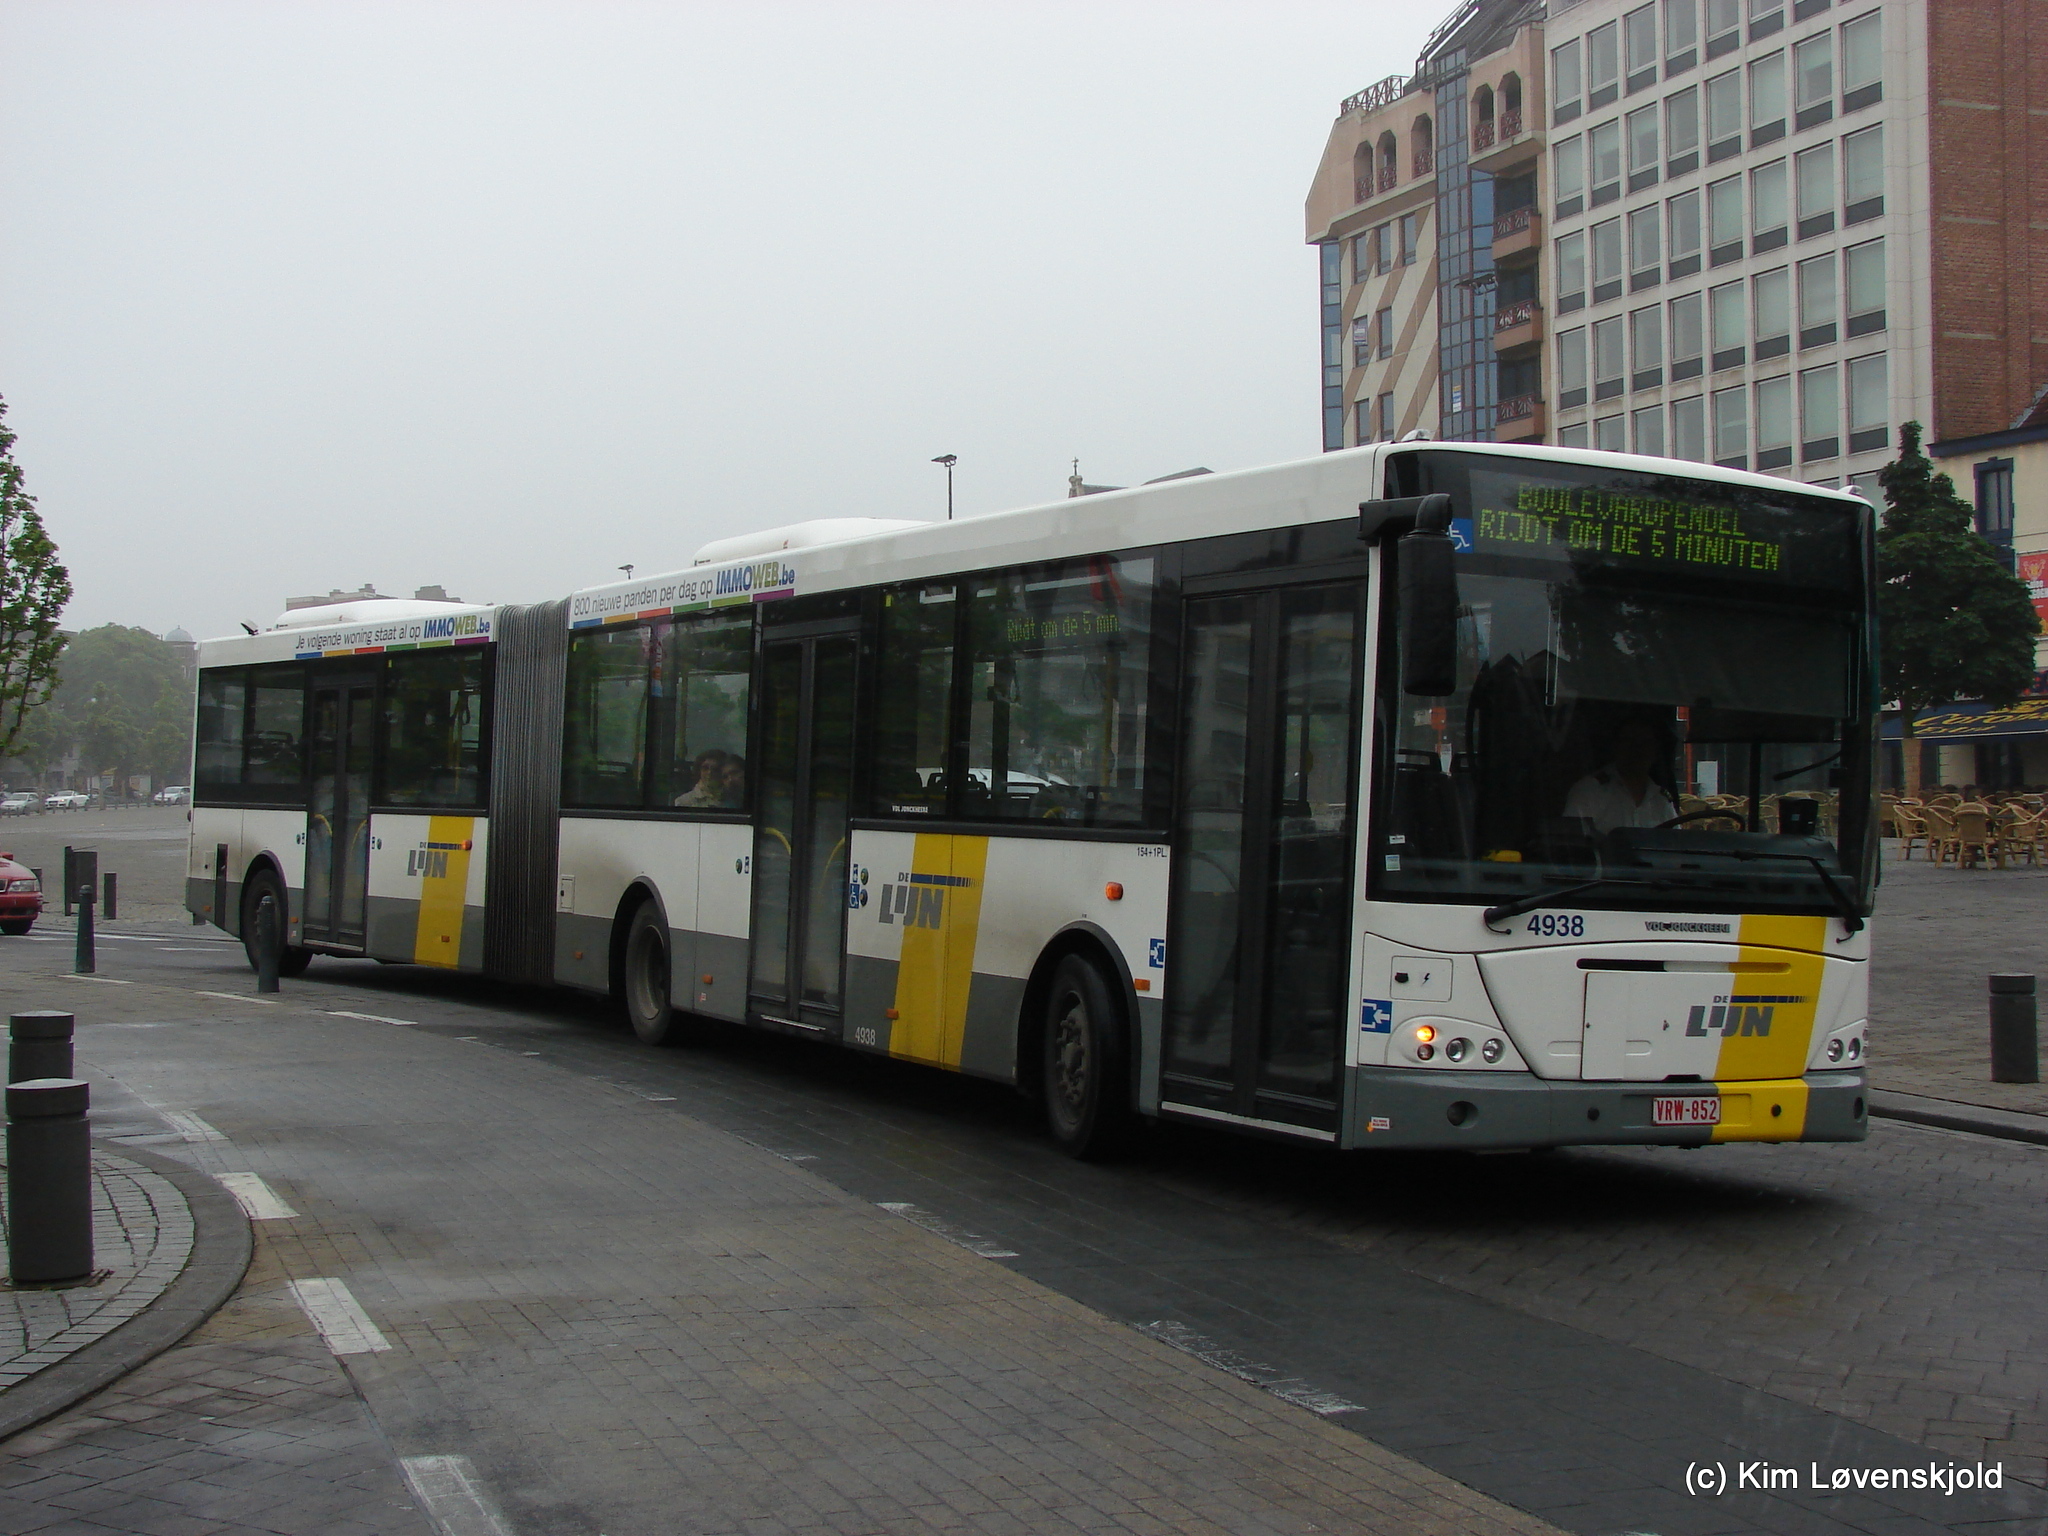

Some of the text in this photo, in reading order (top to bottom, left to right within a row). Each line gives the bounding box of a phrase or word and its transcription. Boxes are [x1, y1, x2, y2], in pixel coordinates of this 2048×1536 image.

[1480, 508, 1779, 572] RIJDT OM DE 5 MINUTEN
[574, 561, 795, 616] 800 nieuwe panden per dag op IMMOWEB.be
[296, 615, 491, 650] Je volgende woning staat al op IMMOWEB.be
[1062, 613, 1078, 637] de
[1083, 610, 1091, 634] 5
[407, 850, 448, 878] LIJN
[898, 872, 909, 882] DE
[878, 884, 944, 930] LIJN
[1527, 914, 1584, 937] 4938
[1644, 921, 1665, 932] VDL
[1713, 995, 1729, 1004] DE
[1685, 1005, 1774, 1037] LIJN
[854, 1026, 876, 1046] 4938
[1656, 1099, 1717, 1121] VRW-852
